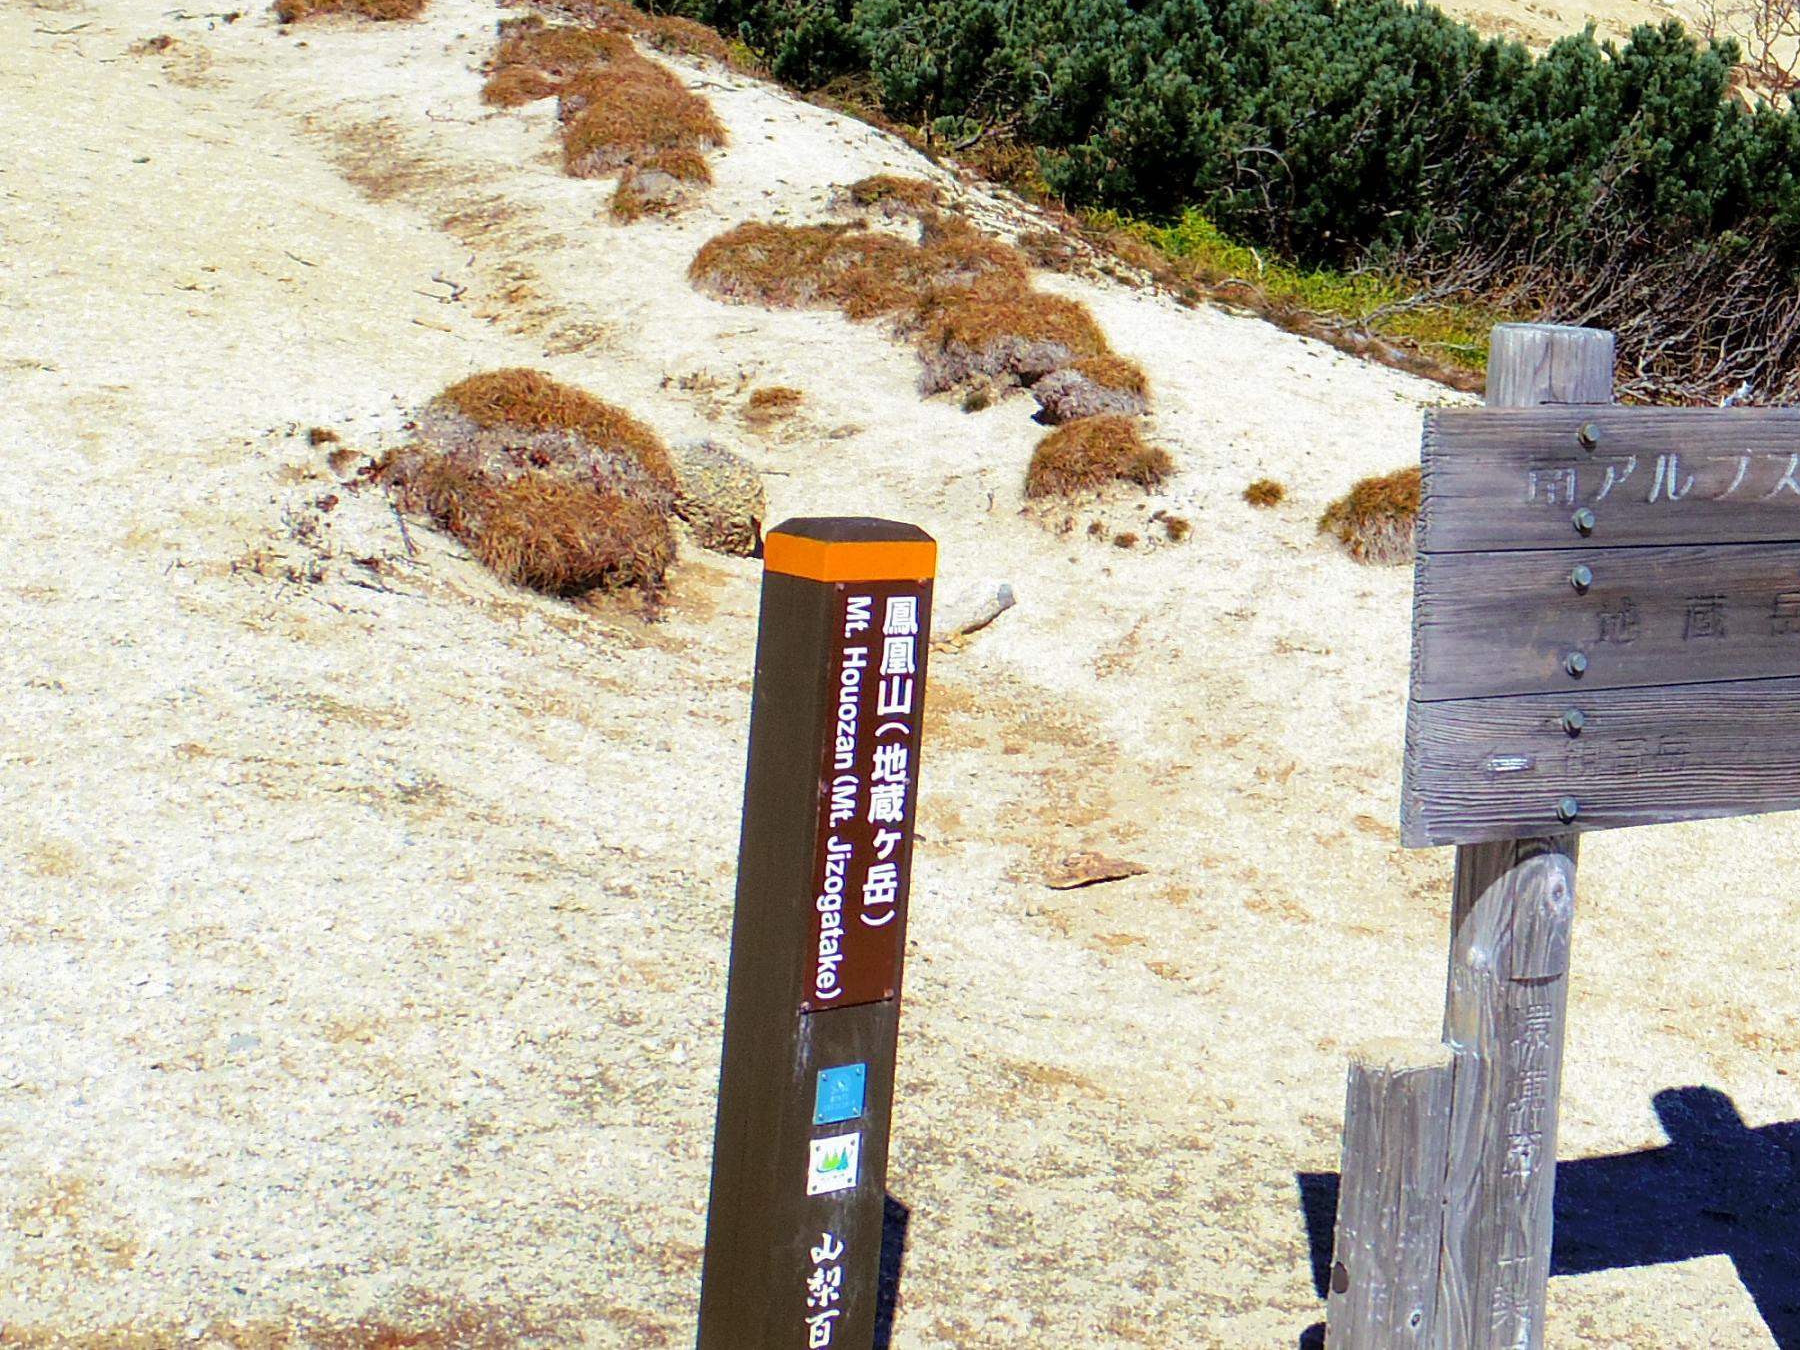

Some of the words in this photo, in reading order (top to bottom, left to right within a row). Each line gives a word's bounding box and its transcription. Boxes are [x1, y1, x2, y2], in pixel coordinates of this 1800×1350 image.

[844, 596, 873, 638] Mt.
[834, 647, 868, 770] Houozan
[829, 775, 859, 828] (Mt.
[815, 836, 852, 999] Jizogatake)
[805, 1232, 843, 1349] 山梨百
